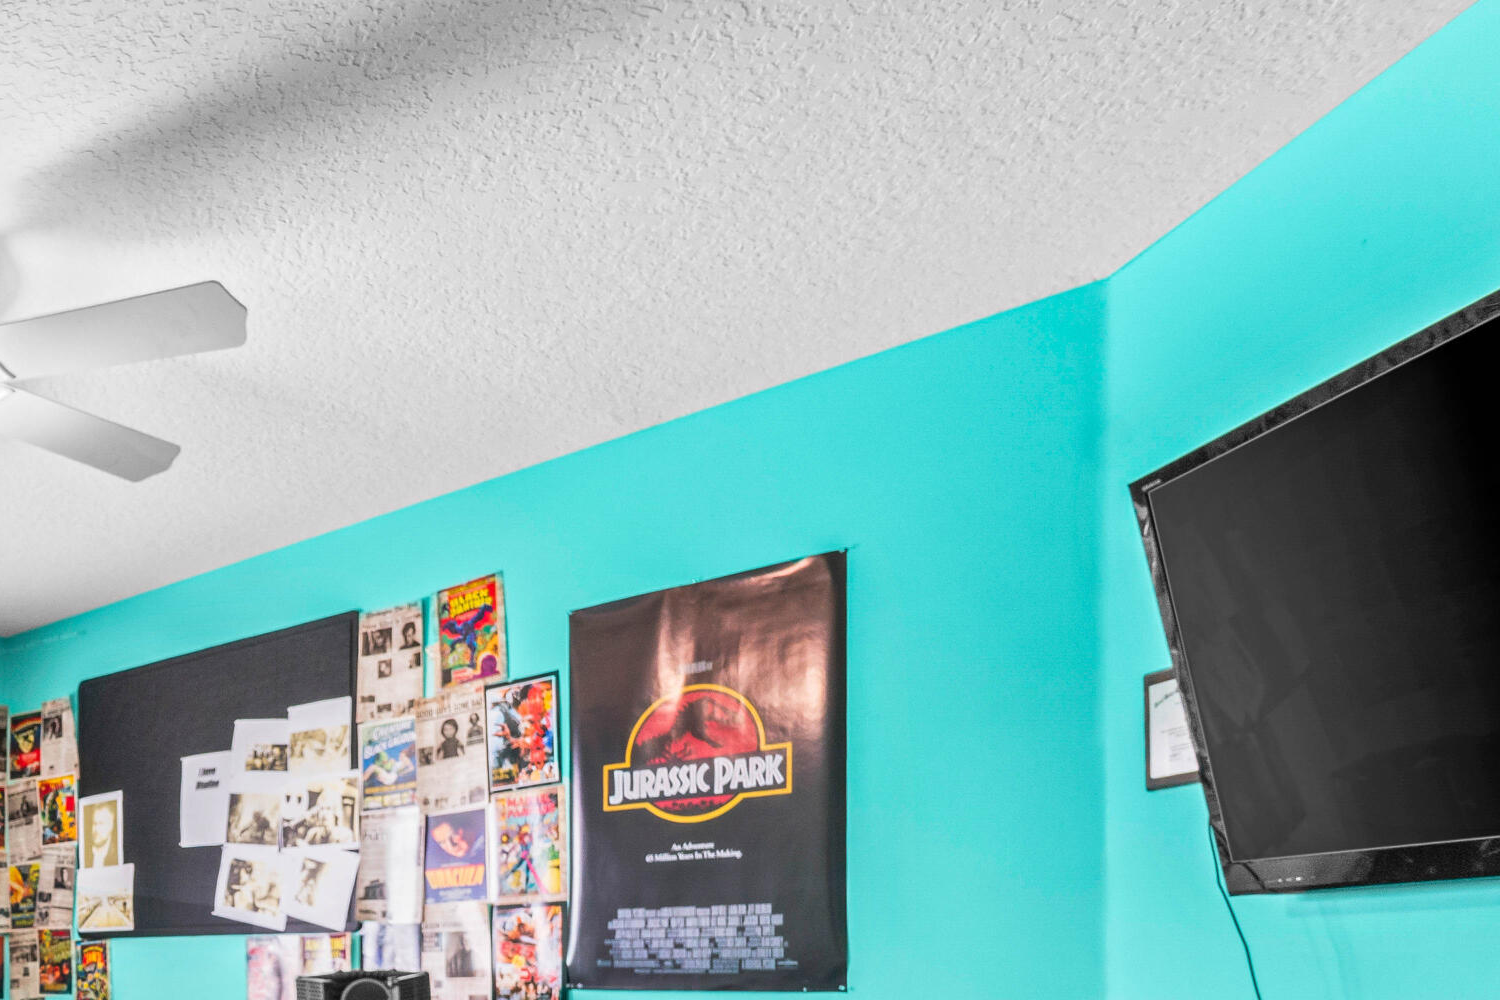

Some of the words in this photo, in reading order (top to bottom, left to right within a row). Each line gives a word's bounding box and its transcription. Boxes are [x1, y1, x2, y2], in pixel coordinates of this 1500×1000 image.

[609, 762, 710, 805] JURASSIC
[714, 754, 785, 794] PARK
[682, 841, 715, 850] Adventure
[654, 853, 677, 861] Million
[677, 851, 694, 860] Years
[424, 863, 485, 890] DRACULA
